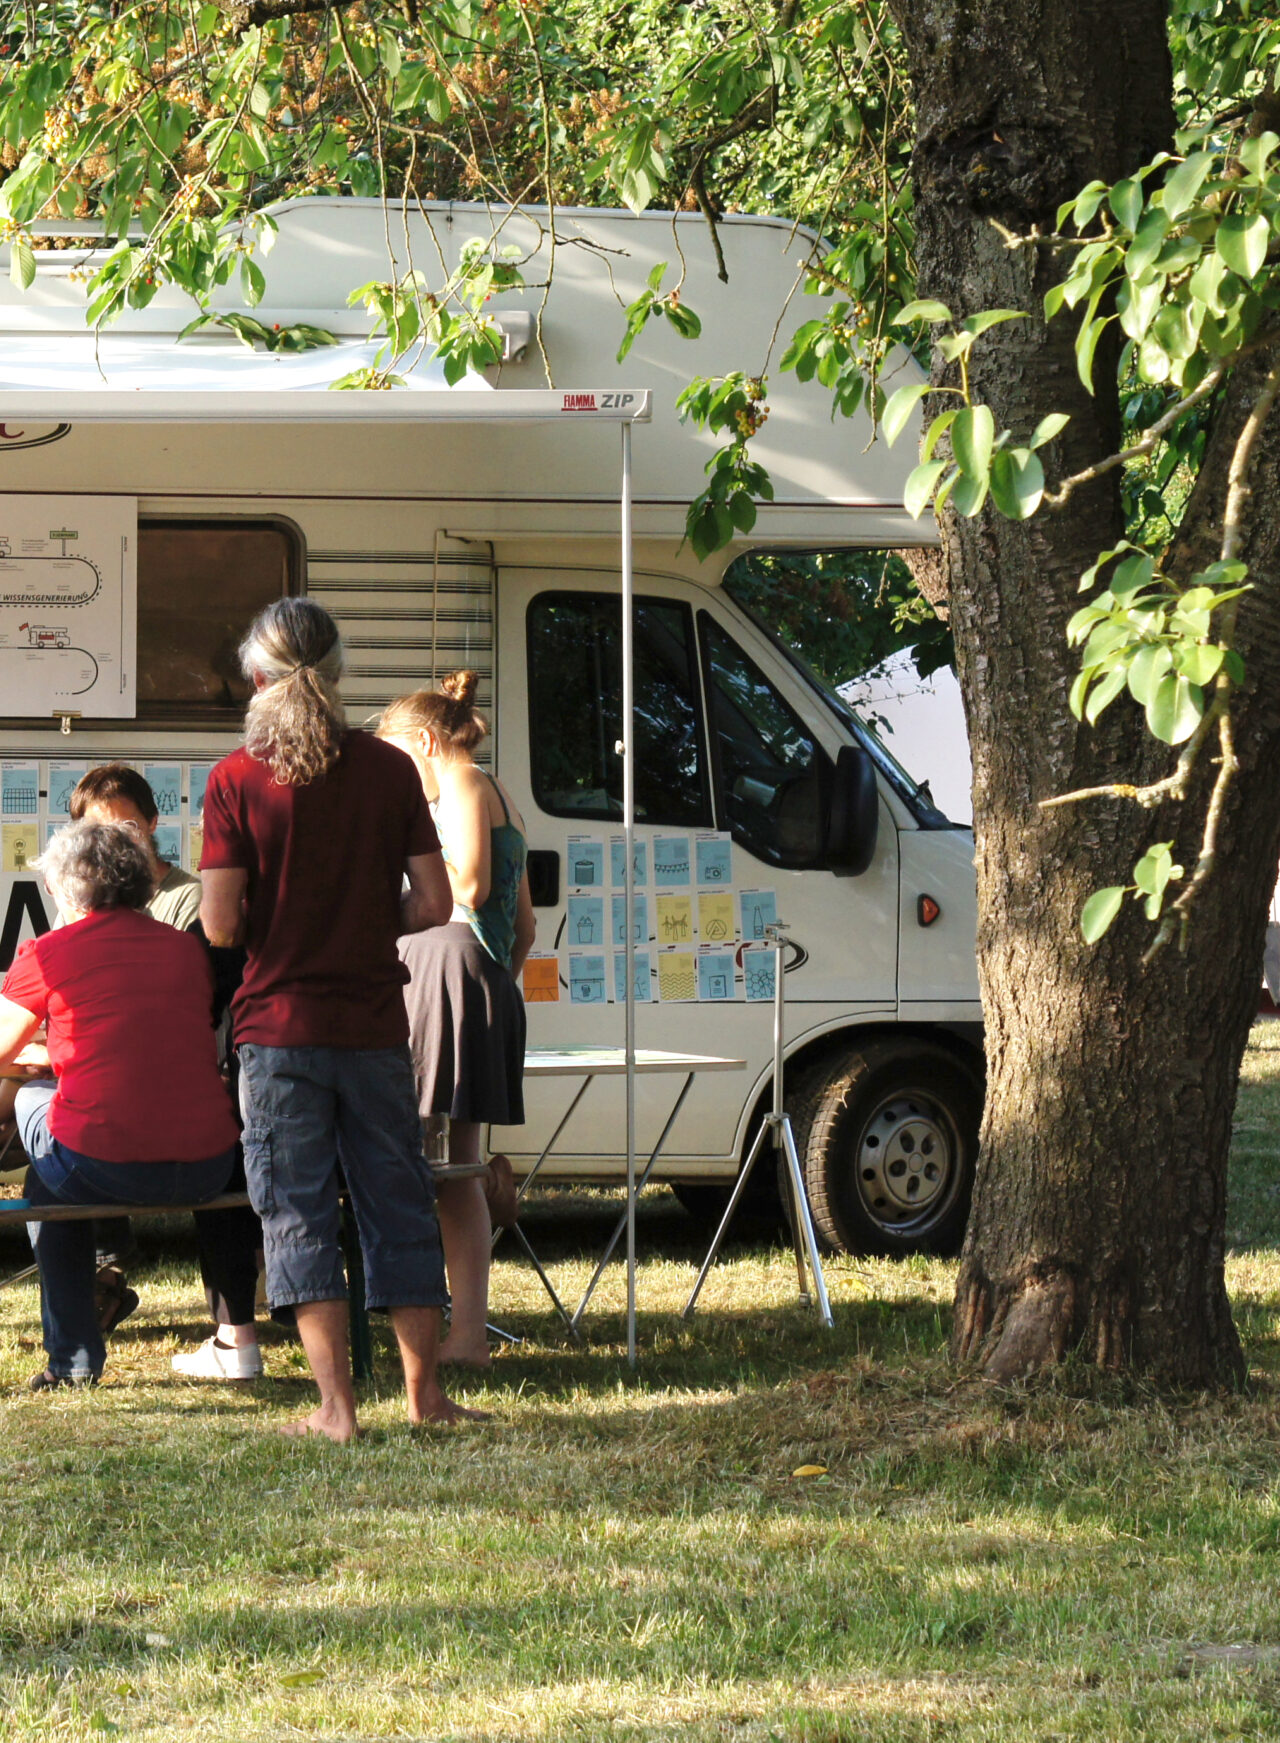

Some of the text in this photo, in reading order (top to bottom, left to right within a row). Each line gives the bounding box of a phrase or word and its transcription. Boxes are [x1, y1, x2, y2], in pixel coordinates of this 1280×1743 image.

[564, 394, 634, 408] FIAMMA ZIP
[3, 591, 88, 602] WISSENSGENERIERUNG
